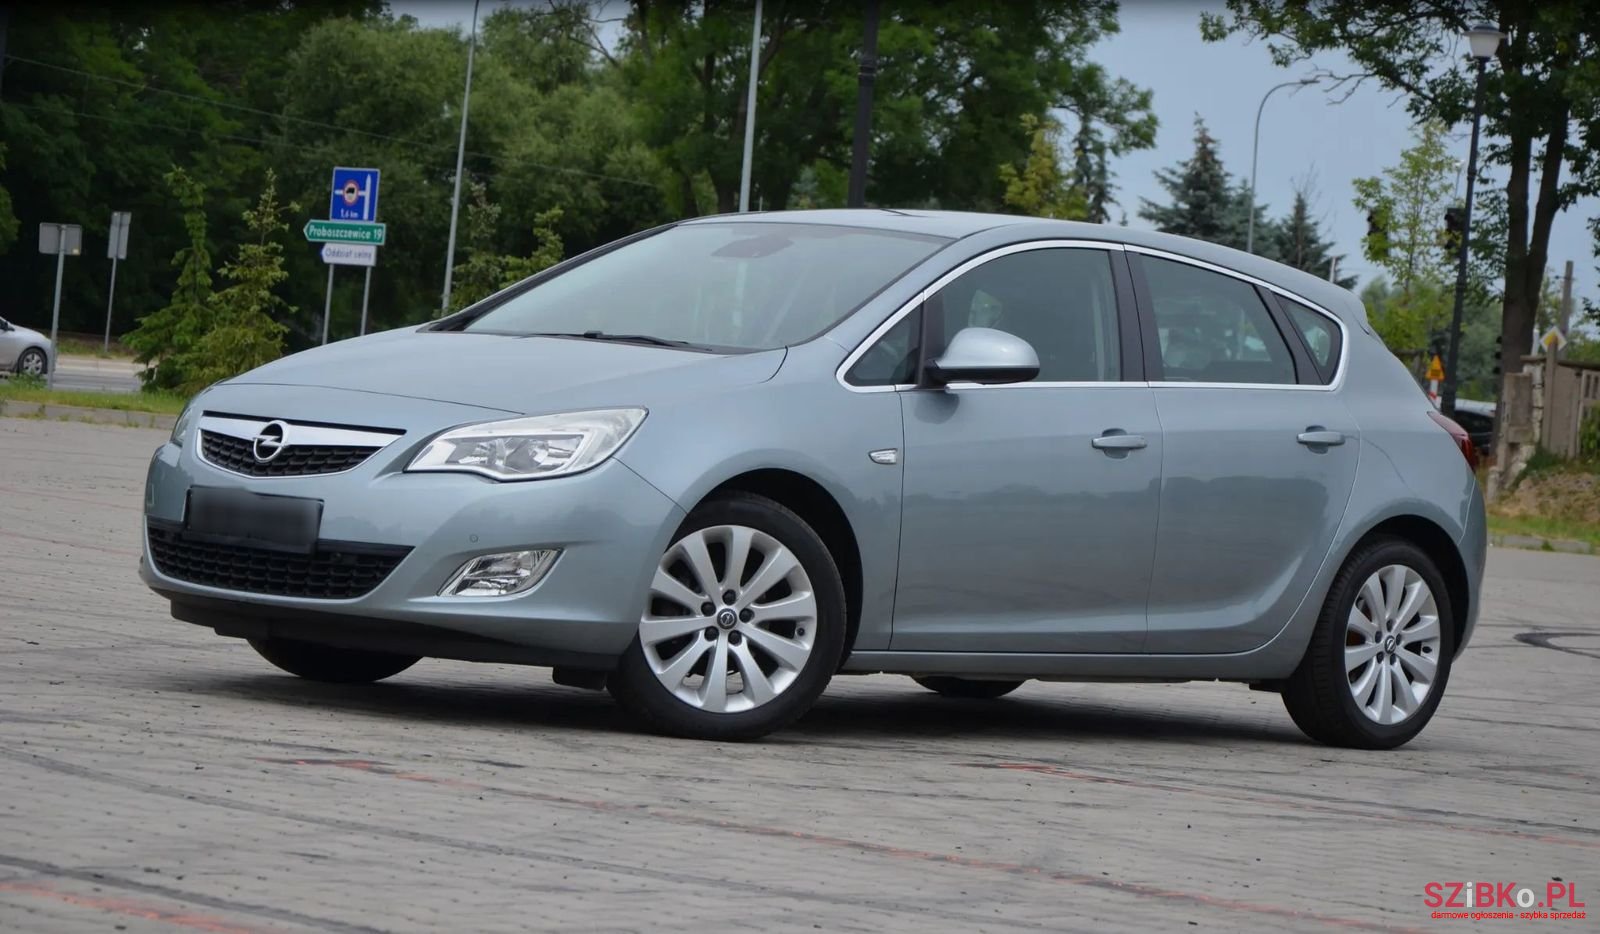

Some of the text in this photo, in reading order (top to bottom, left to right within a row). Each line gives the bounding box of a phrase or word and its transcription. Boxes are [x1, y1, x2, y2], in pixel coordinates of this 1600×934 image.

[350, 209, 359, 218] km
[309, 225, 383, 240] Proboszczewice 19
